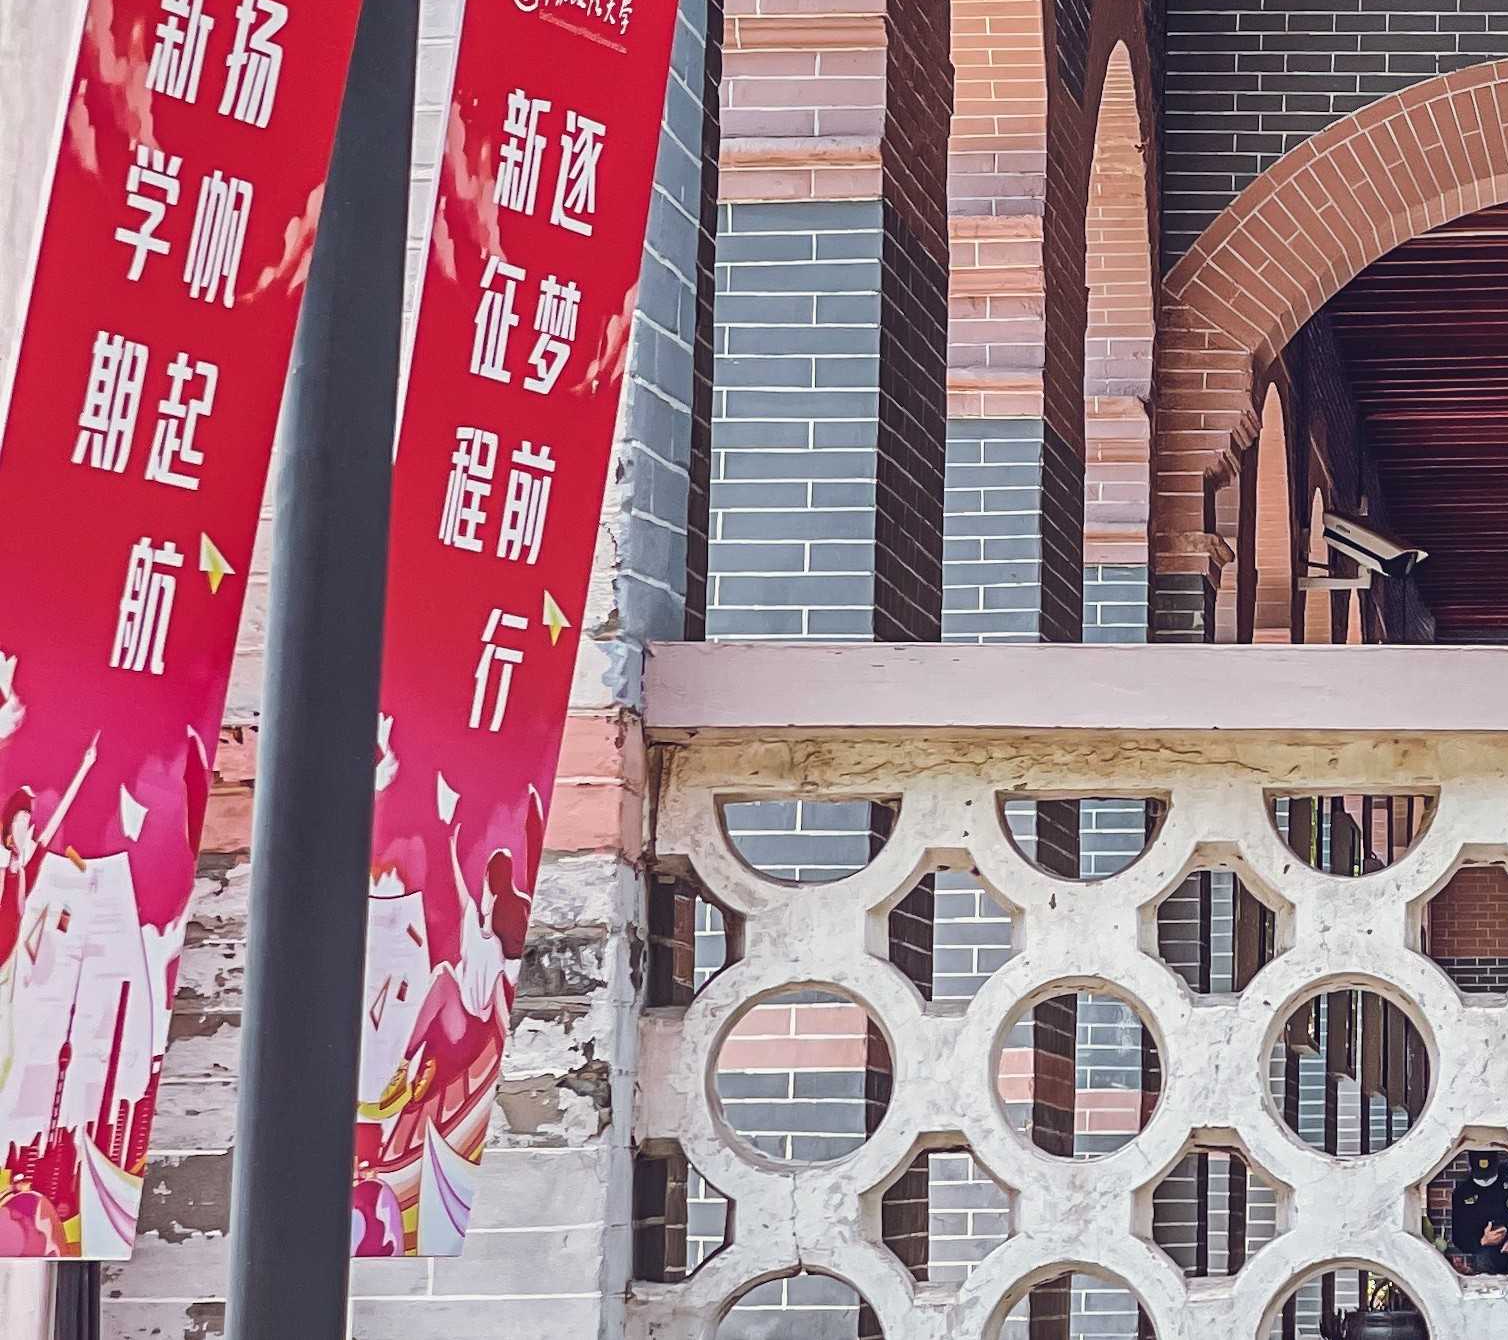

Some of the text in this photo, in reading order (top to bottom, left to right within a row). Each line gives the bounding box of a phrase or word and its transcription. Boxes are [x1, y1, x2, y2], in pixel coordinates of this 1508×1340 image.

[438, 88, 552, 553] 新征程
[469, 110, 607, 732] 逐梦前行
